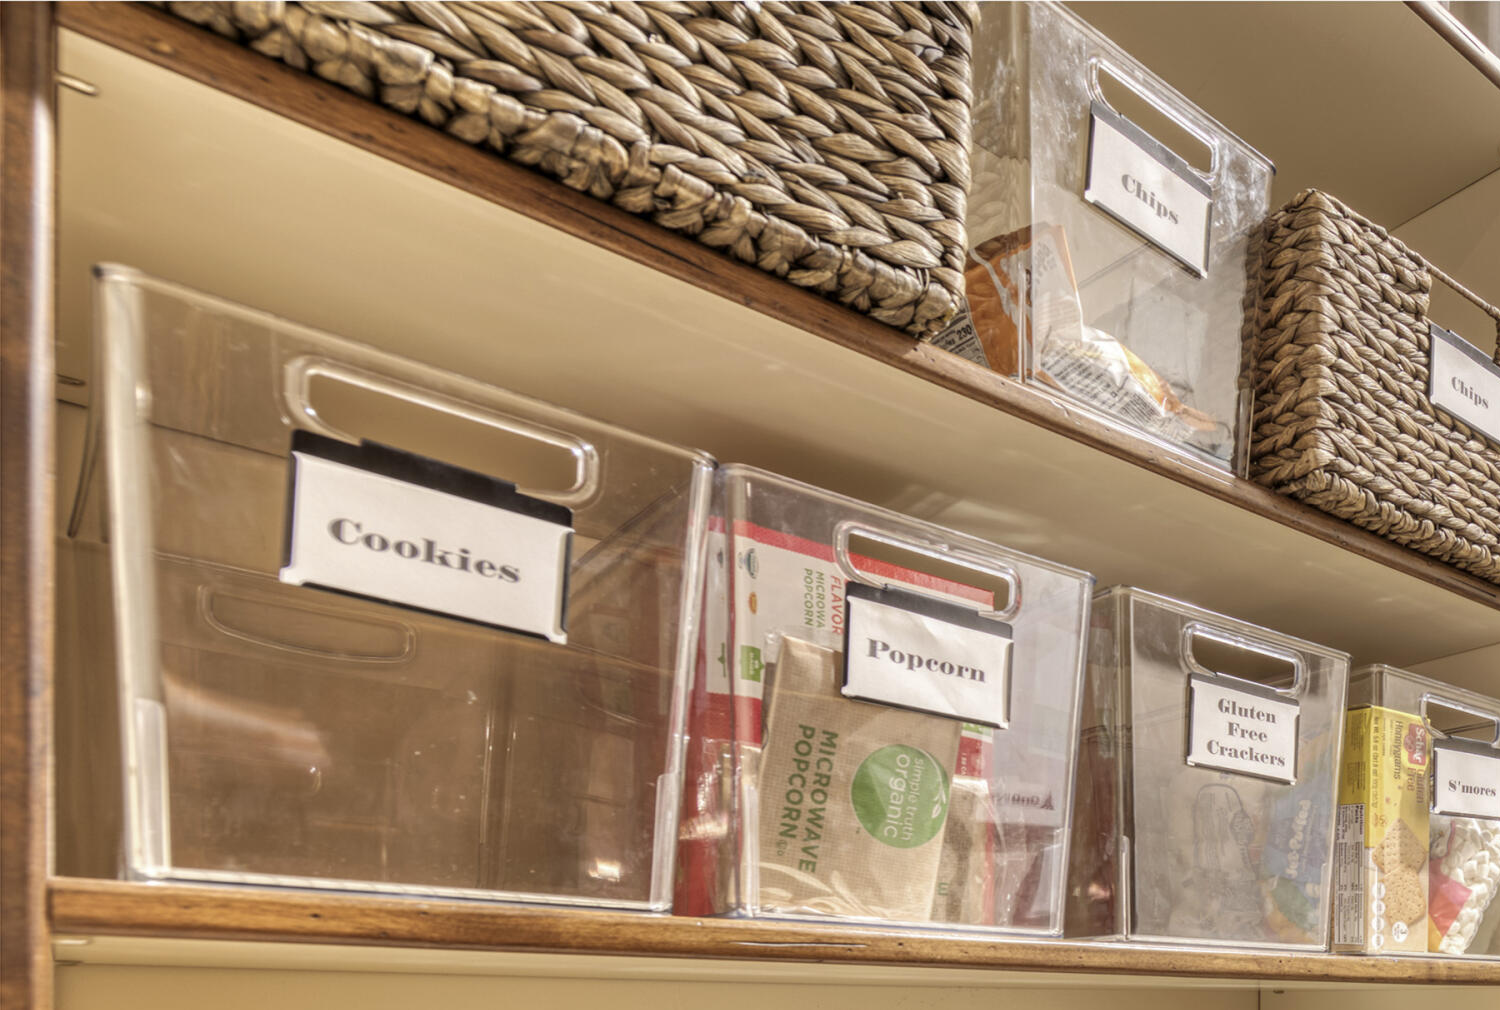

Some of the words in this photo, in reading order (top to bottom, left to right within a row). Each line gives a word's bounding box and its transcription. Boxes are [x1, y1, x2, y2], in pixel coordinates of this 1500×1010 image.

[1120, 173, 1180, 226] Chips
[1450, 375, 1490, 412] Chips
[327, 517, 521, 585] Cookies
[804, 568, 814, 626] POPCORN
[815, 571, 825, 629] MICROWA
[831, 575, 844, 636] FLAVOR
[866, 638, 987, 685] Popcorn
[1218, 698, 1277, 725] Gluten
[1227, 722, 1268, 744] Free
[912, 757, 925, 800] simple
[1206, 740, 1286, 769] Crackers
[783, 724, 816, 839] POPCORN
[798, 729, 839, 873] MICROWAVE
[884, 754, 911, 839] organic
[1447, 778, 1498, 798] S'mores
[901, 803, 919, 842] truth
